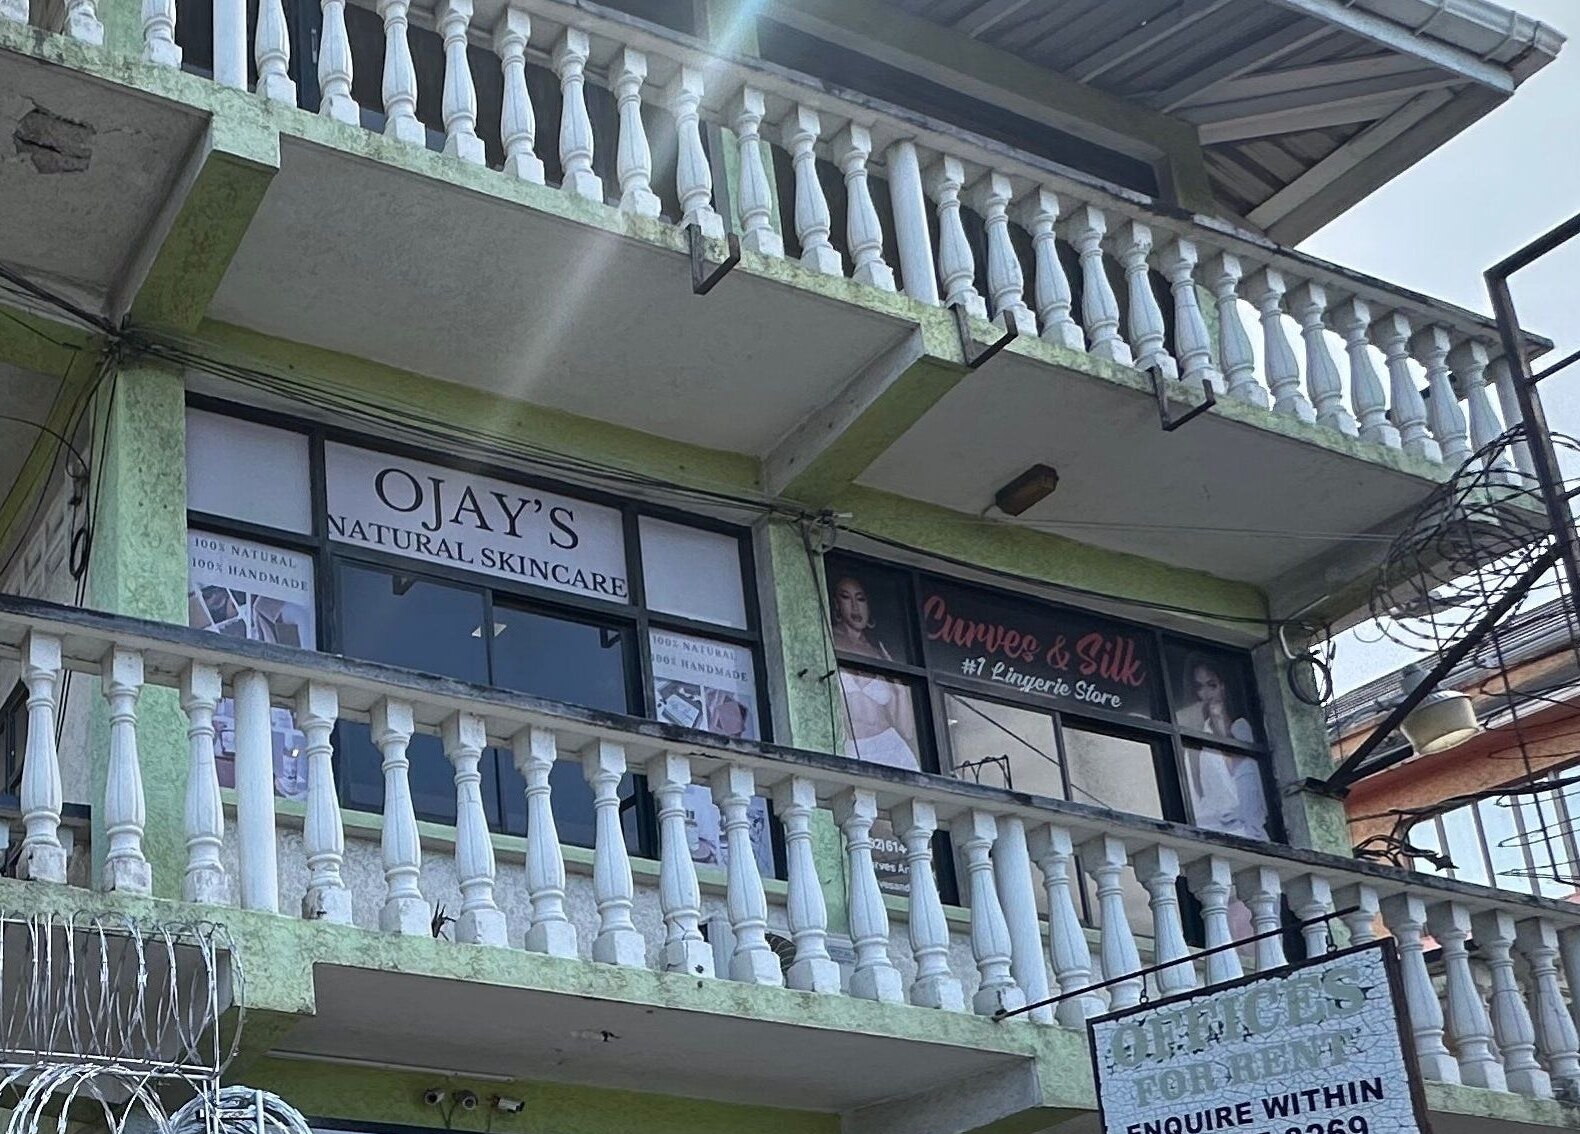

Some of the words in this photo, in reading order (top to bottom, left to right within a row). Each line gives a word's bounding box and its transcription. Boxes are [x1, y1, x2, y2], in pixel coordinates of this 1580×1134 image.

[374, 467, 580, 550] OJAY'S
[228, 564, 309, 592] HANDMADE
[231, 544, 297, 569] NATURAL
[327, 513, 474, 564] NATURAL
[481, 547, 628, 599] SKINCARE
[682, 641, 738, 661] NATURAL
[923, 594, 1040, 664] Curves
[1045, 634, 1071, 672] &
[1075, 631, 1146, 688] Silk
[680, 658, 749, 682] HANDMADE
[960, 656, 987, 677] #1
[991, 660, 1071, 697] Lingerie
[1074, 679, 1123, 708] Store
[1109, 966, 1368, 1069] OFFICES
[1132, 1060, 1219, 1108] FOR
[1228, 1029, 1358, 1084] RENT
[1261, 1076, 1385, 1120] WITHIN
